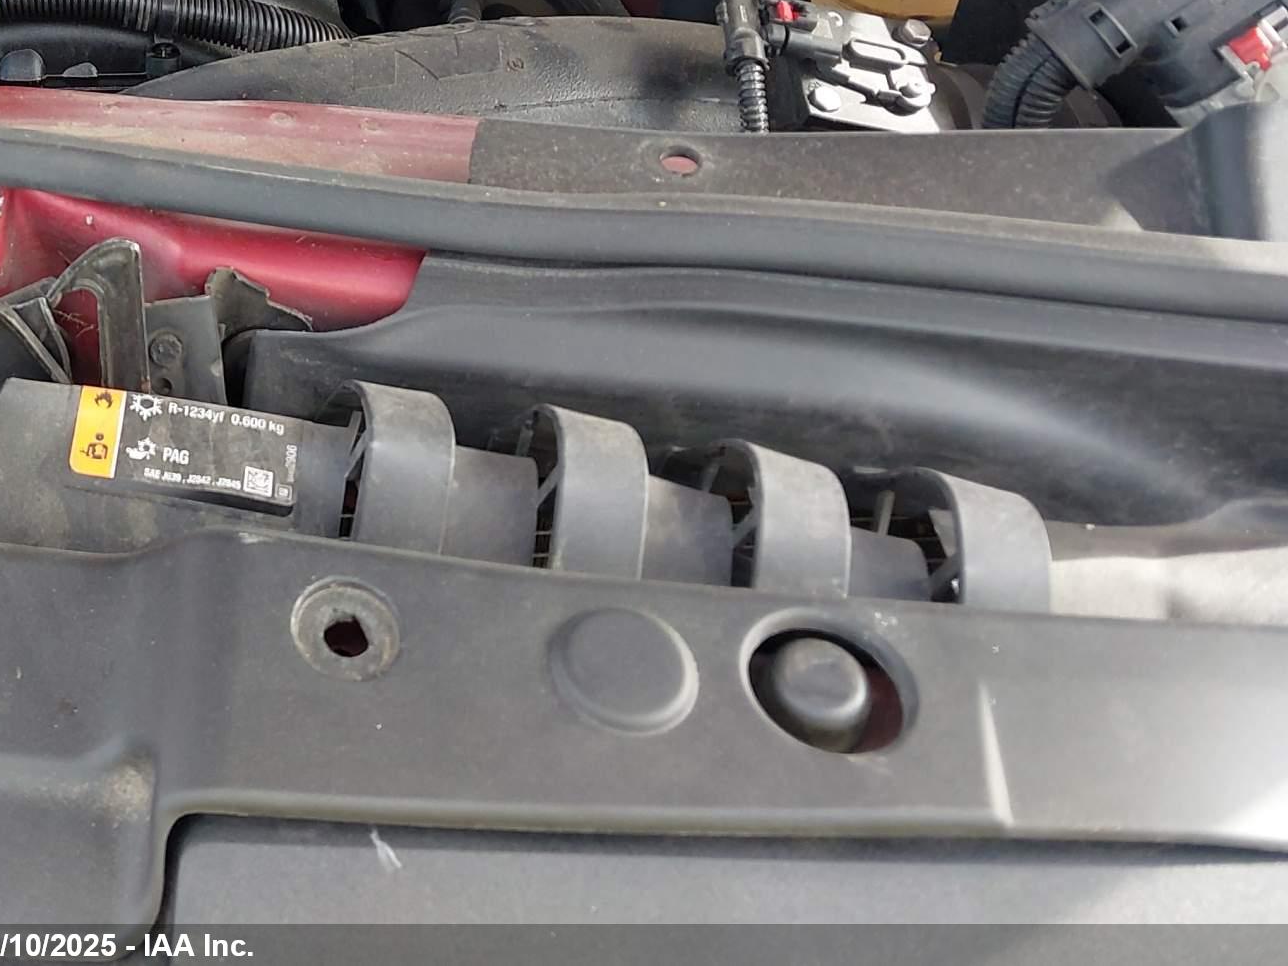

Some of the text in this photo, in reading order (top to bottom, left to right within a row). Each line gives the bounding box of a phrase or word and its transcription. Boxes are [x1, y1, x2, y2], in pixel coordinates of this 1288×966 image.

[168, 402, 285, 436] R-1234yf 0.600 kg
[162, 447, 190, 465] PAG
[144, 467, 161, 480] SAE
